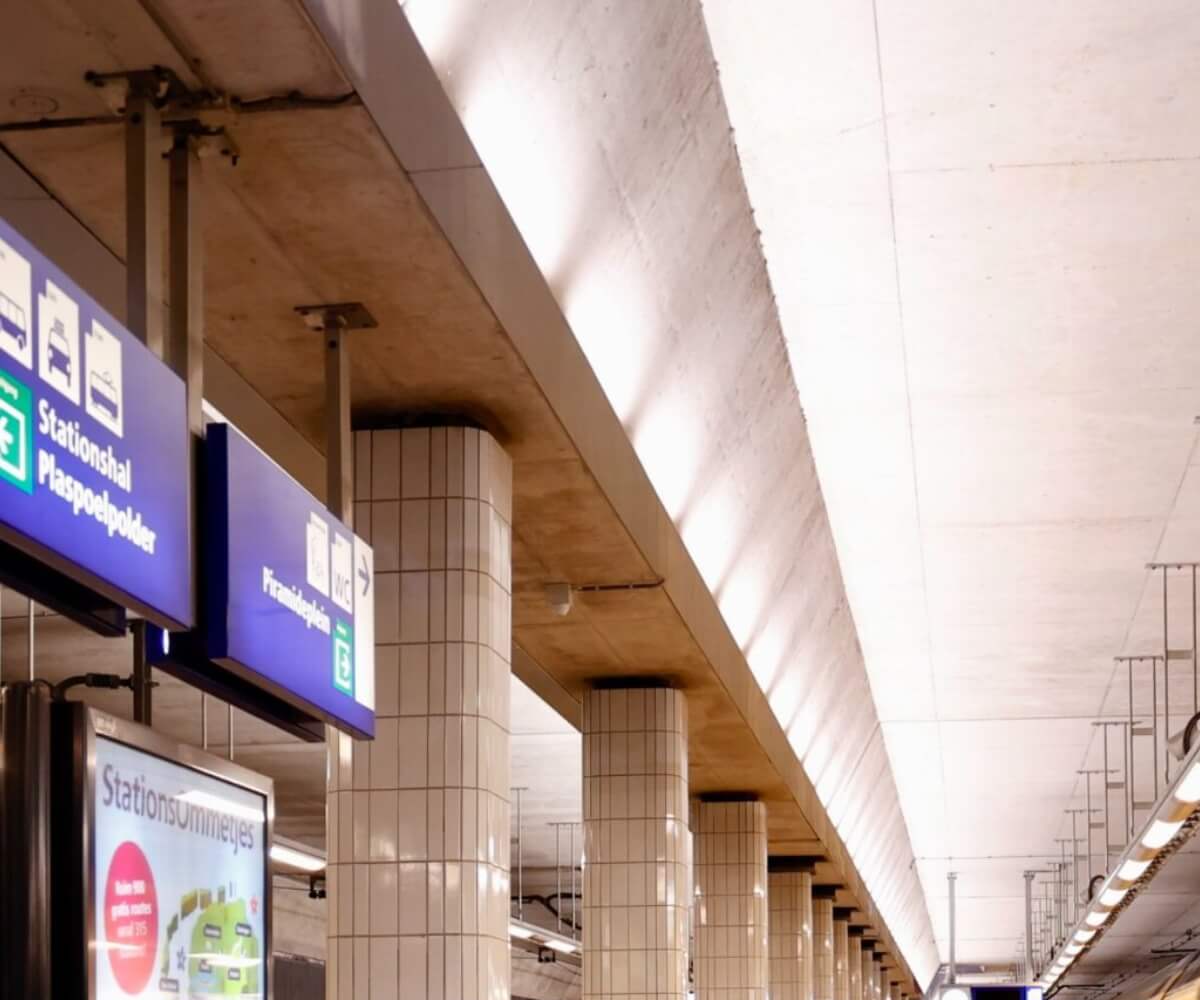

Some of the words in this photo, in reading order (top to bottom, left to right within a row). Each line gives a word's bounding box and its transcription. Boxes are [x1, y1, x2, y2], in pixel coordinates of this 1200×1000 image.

[38, 398, 132, 493] Stationshal
[38, 448, 156, 555] Plaspoelpolder
[262, 565, 331, 636] Piramideplein
[335, 571, 350, 605] WC
